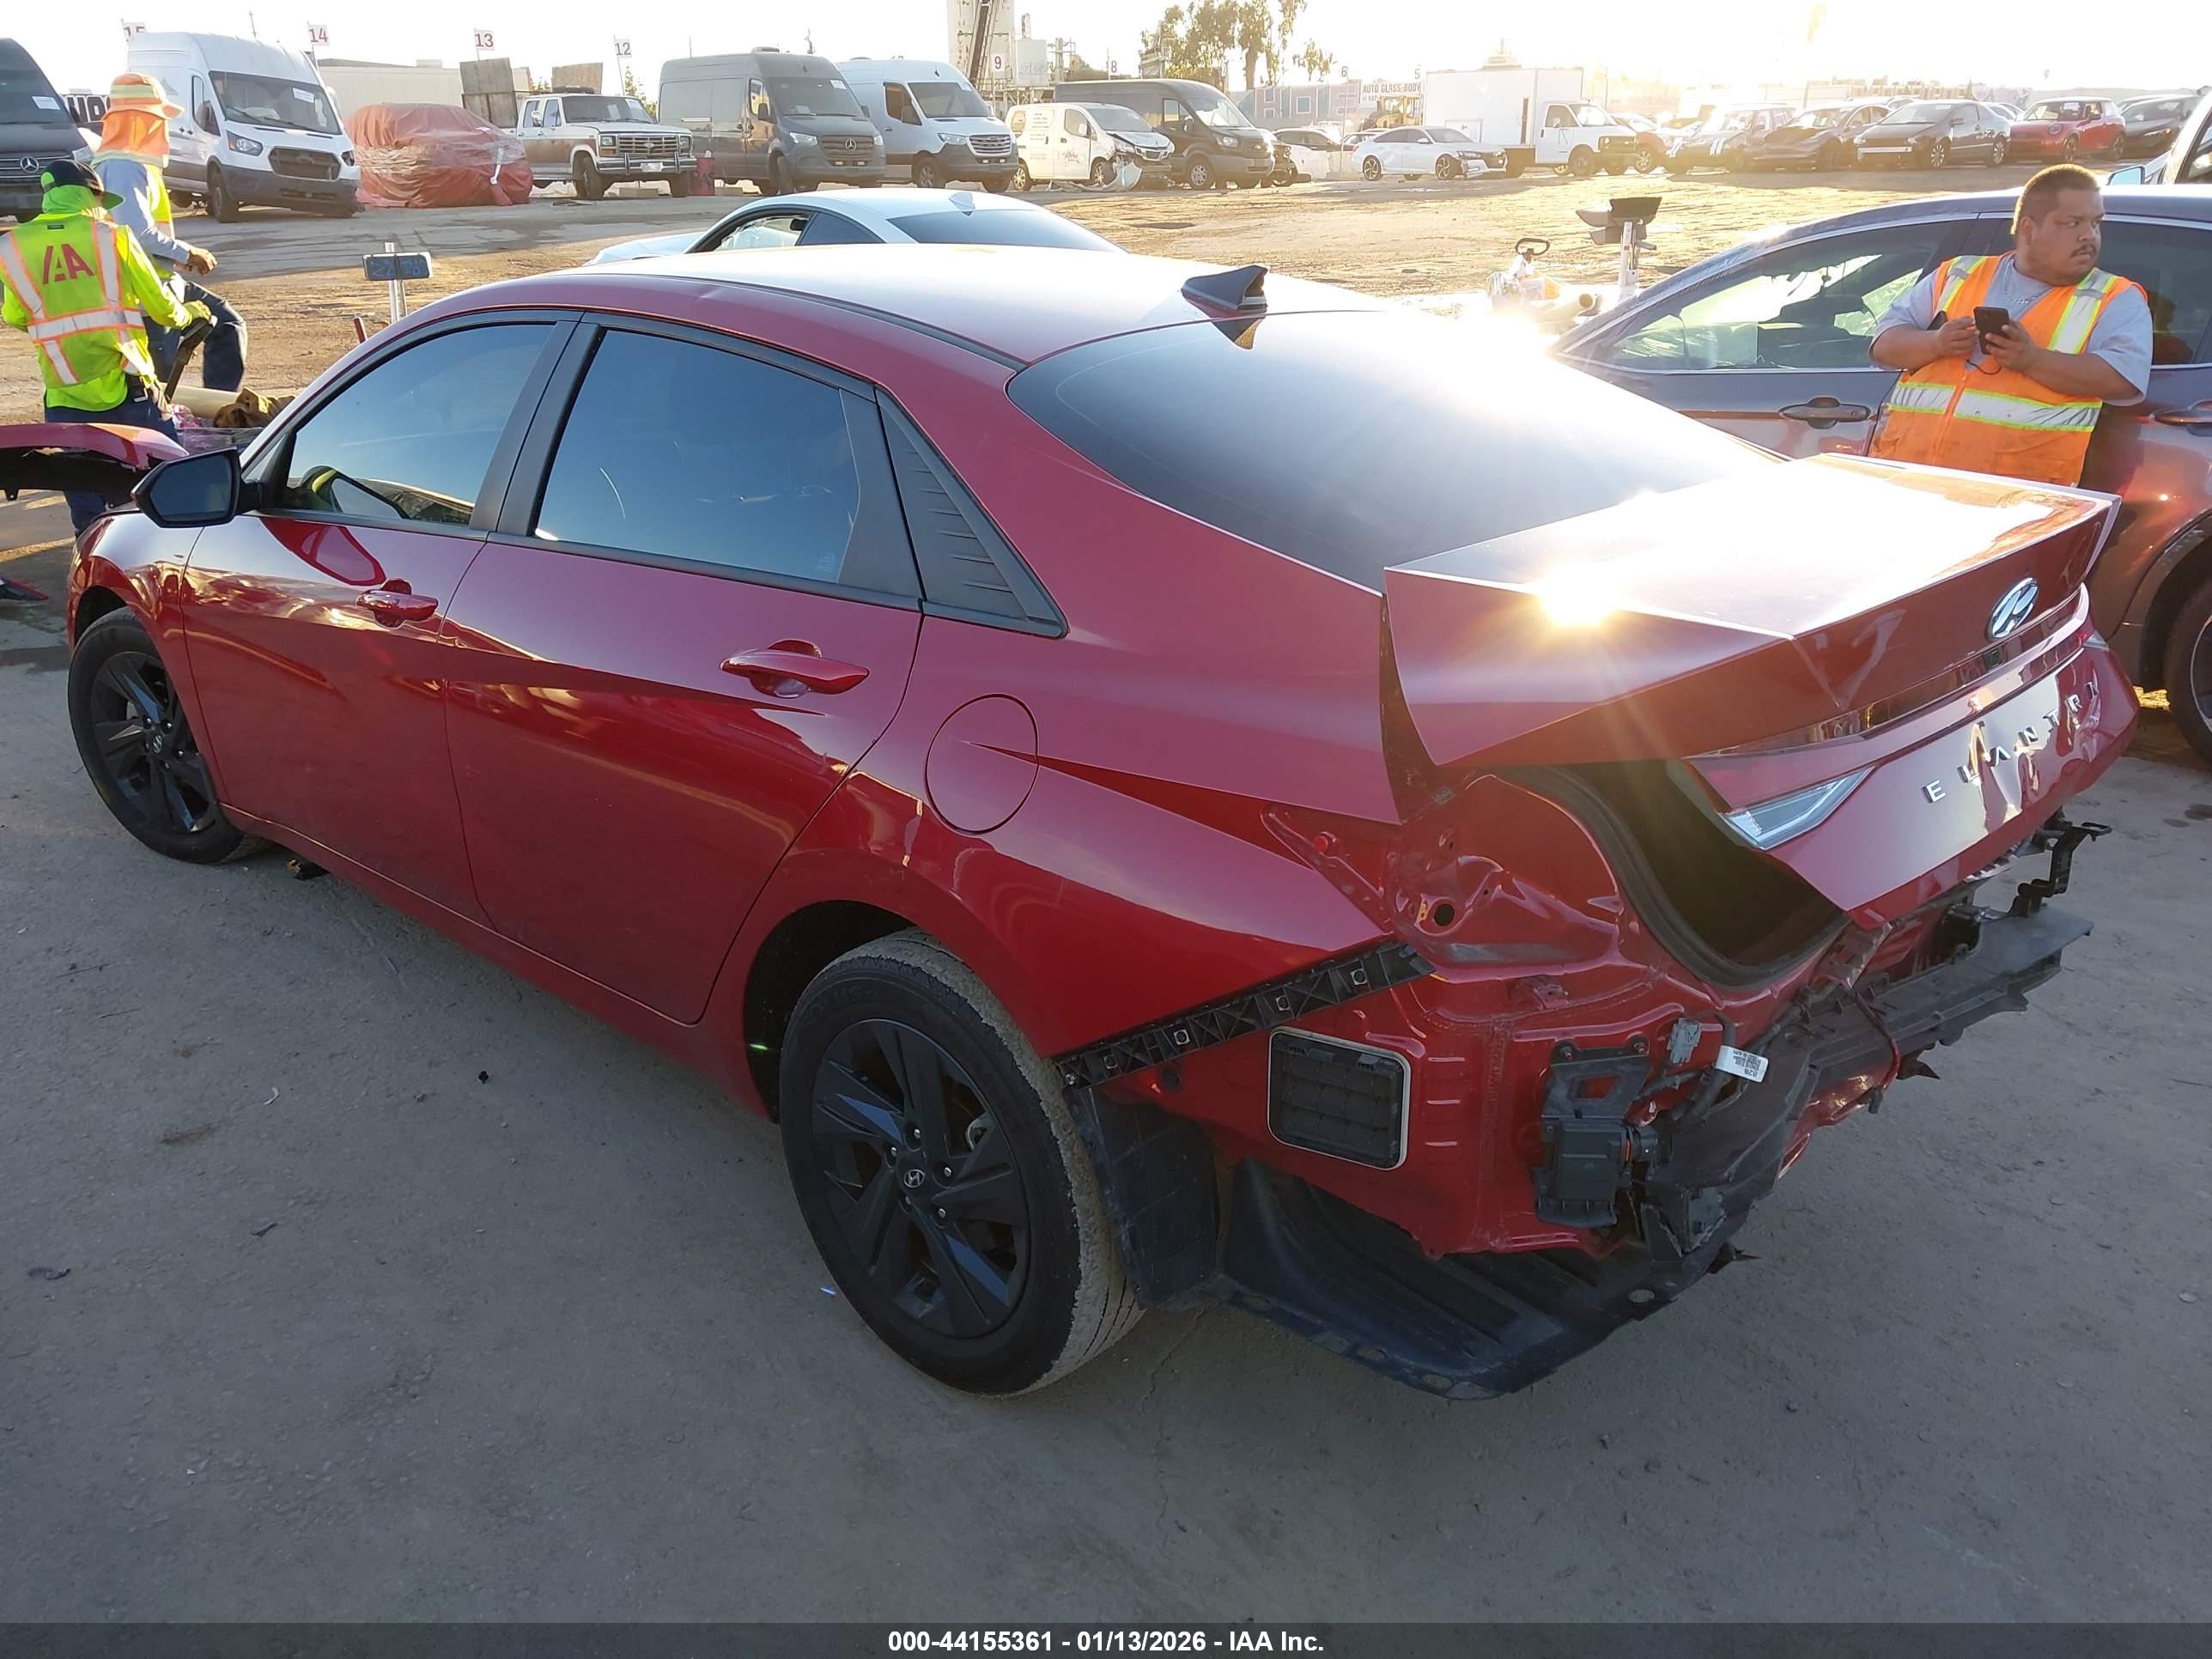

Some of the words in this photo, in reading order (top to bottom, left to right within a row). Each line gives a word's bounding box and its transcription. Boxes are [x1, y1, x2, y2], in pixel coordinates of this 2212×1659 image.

[309, 27, 328, 42] 14
[475, 33, 494, 47] 13
[615, 42, 631, 55] 12
[994, 56, 1001, 69] 9
[1111, 60, 1117, 72] 8
[1341, 66, 1347, 76] 6
[1414, 69, 1420, 79] 5
[1363, 84, 1379, 93] AUTO
[1921, 682, 2100, 804] ELANTRA
